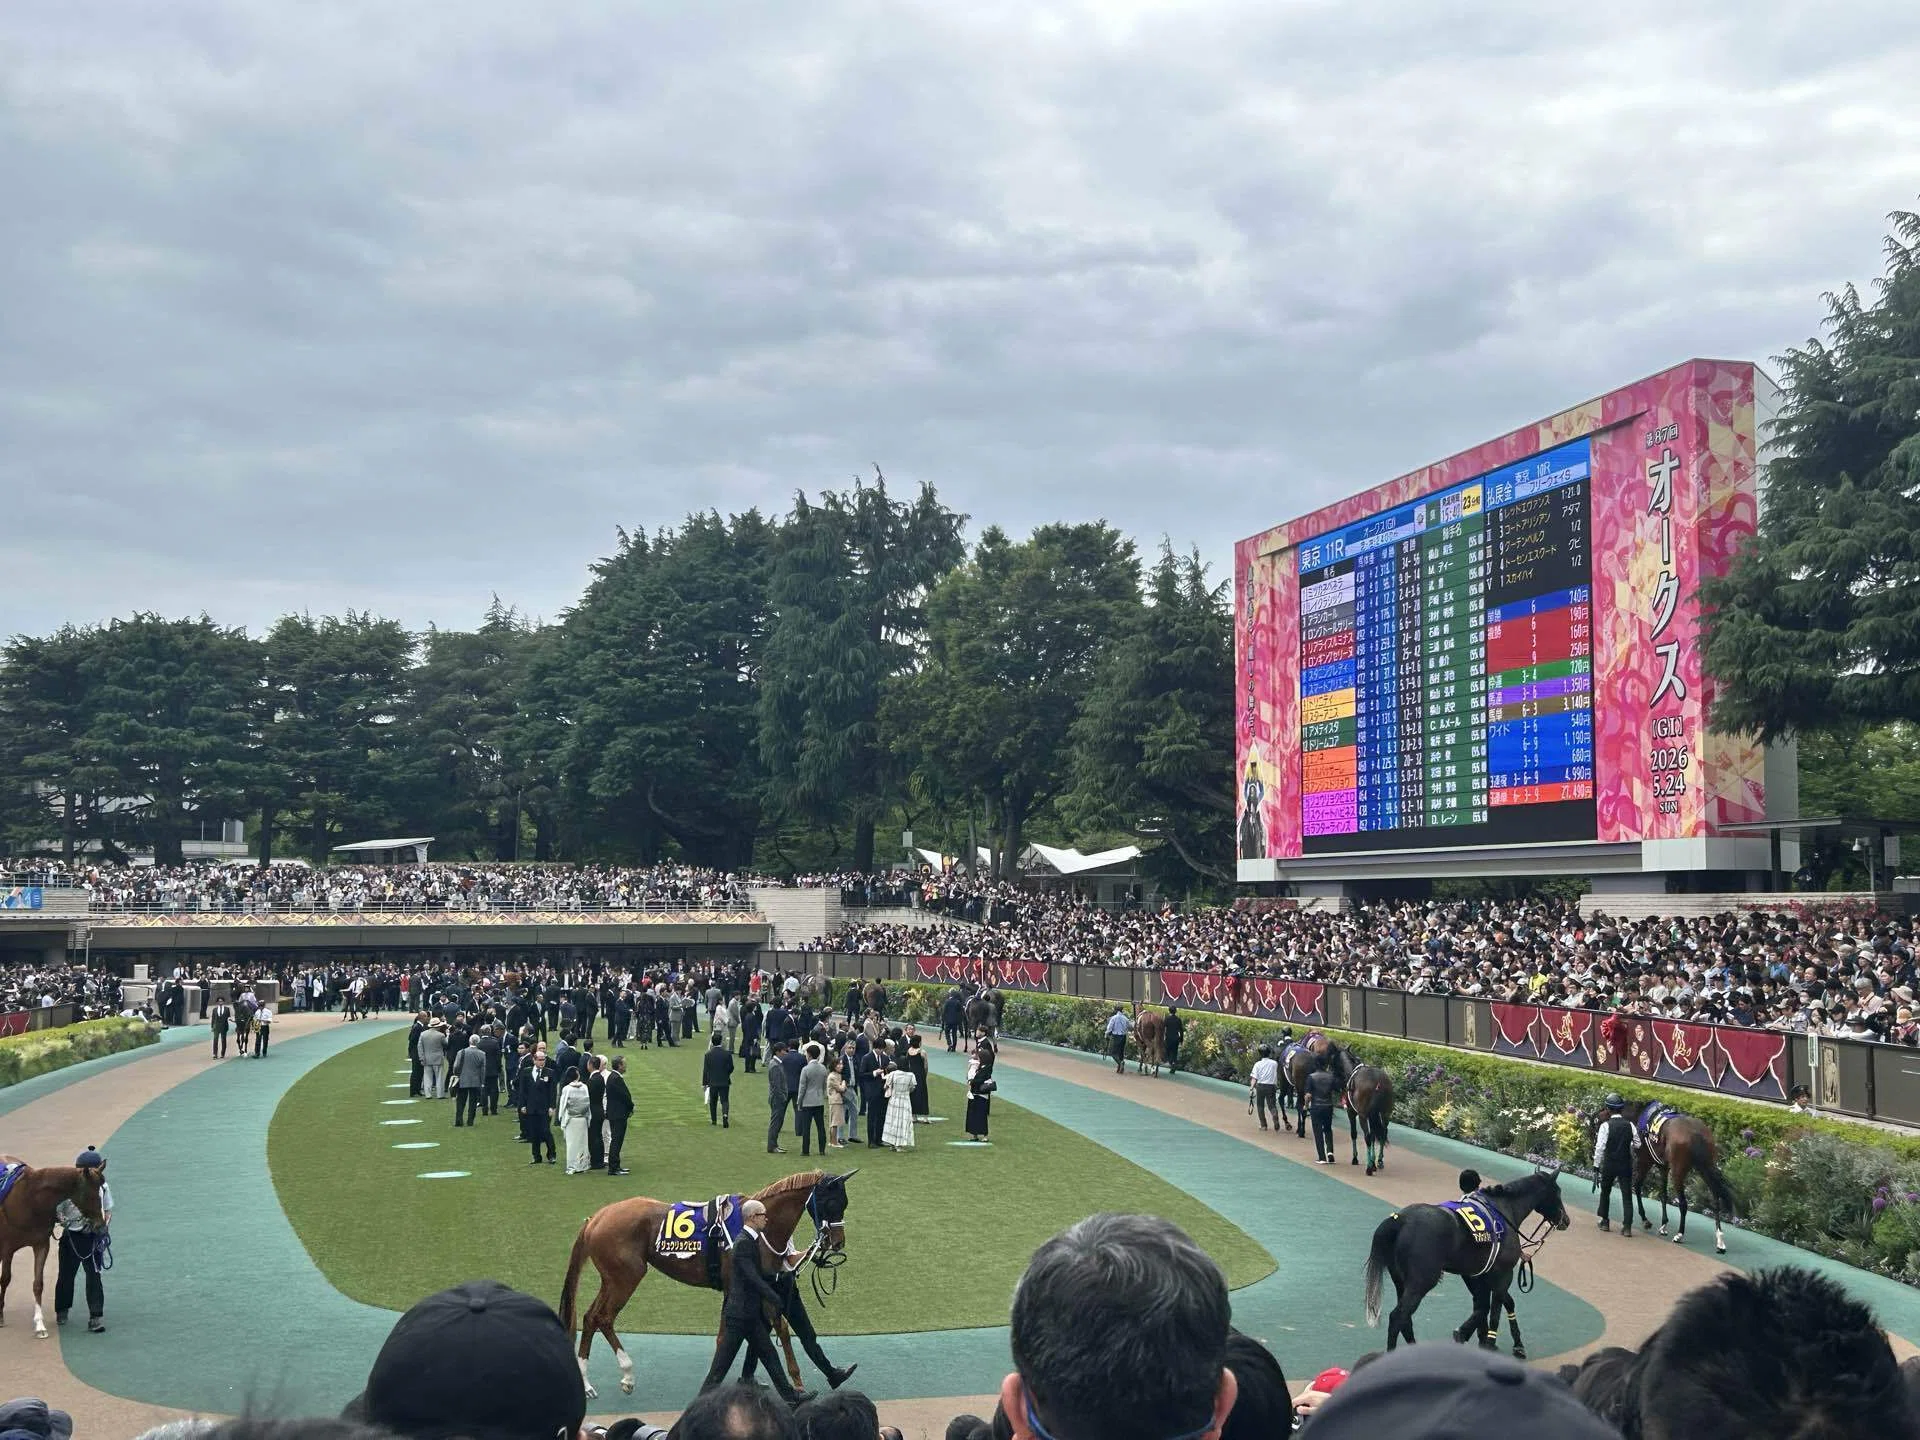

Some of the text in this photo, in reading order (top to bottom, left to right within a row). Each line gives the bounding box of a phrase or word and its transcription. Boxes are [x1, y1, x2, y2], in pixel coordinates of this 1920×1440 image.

[1486, 480, 1512, 508] 払戻金
[1561, 500, 1580, 518] アタマ
[1570, 518, 1580, 534] 1/2
[1301, 545, 1320, 571] 東京
[1325, 537, 1343, 561] 11R
[1571, 553, 1580, 568] 1/2
[1647, 448, 1686, 708] オークス
[1308, 721, 1338, 736] アメティスタ
[1488, 723, 1510, 738] ワイド
[1309, 735, 1338, 750] ドリームコア
[1651, 746, 1688, 773] 2026
[1653, 773, 1686, 798] 5.24
[1659, 801, 1678, 814] SUN
[1441, 812, 1456, 825] レーン
[665, 1209, 695, 1239] 16
[1456, 1207, 1486, 1232] 15
